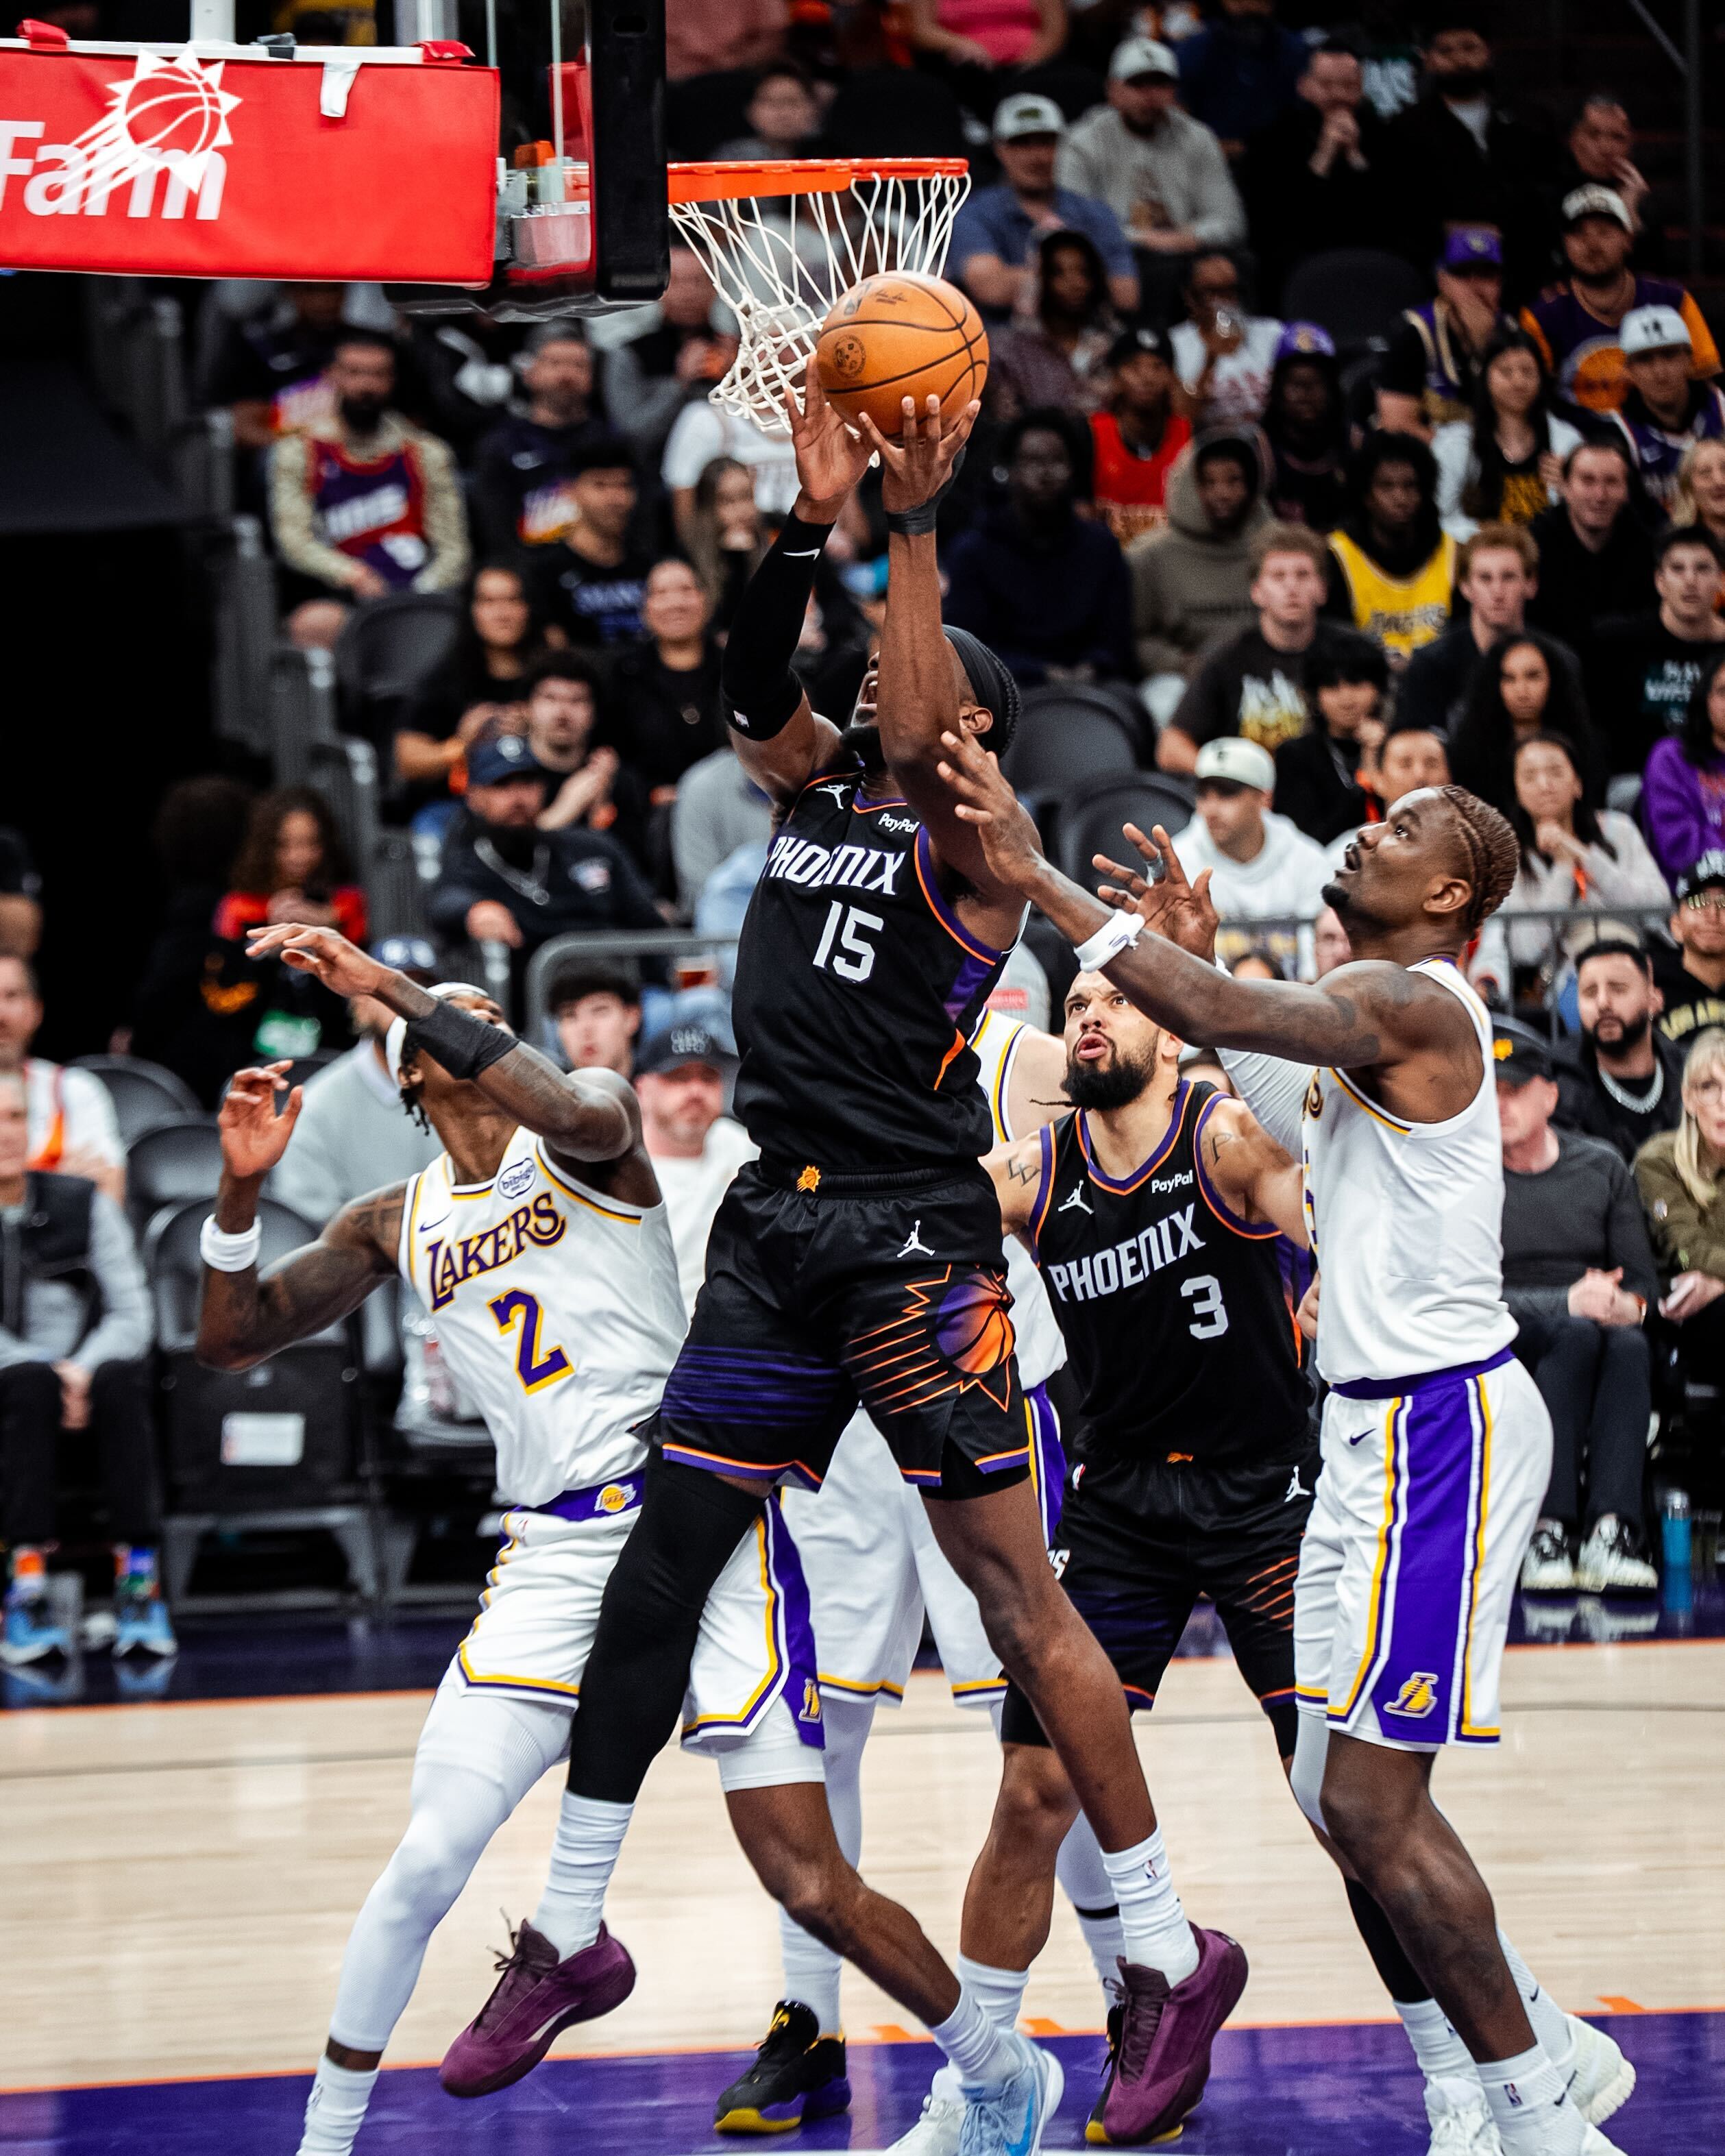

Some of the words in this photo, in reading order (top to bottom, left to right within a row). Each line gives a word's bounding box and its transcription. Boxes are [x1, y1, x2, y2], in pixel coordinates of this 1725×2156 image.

[0, 120, 227, 221] Farm
[878, 813, 920, 833] PayPal
[813, 900, 884, 983] 15
[1151, 1169, 1194, 1194] PayPal
[426, 1191, 568, 1313] LAKERS
[1047, 1202, 1207, 1302] PHOENIX
[487, 1287, 576, 1396] 2
[1179, 1275, 1229, 1340] 3
